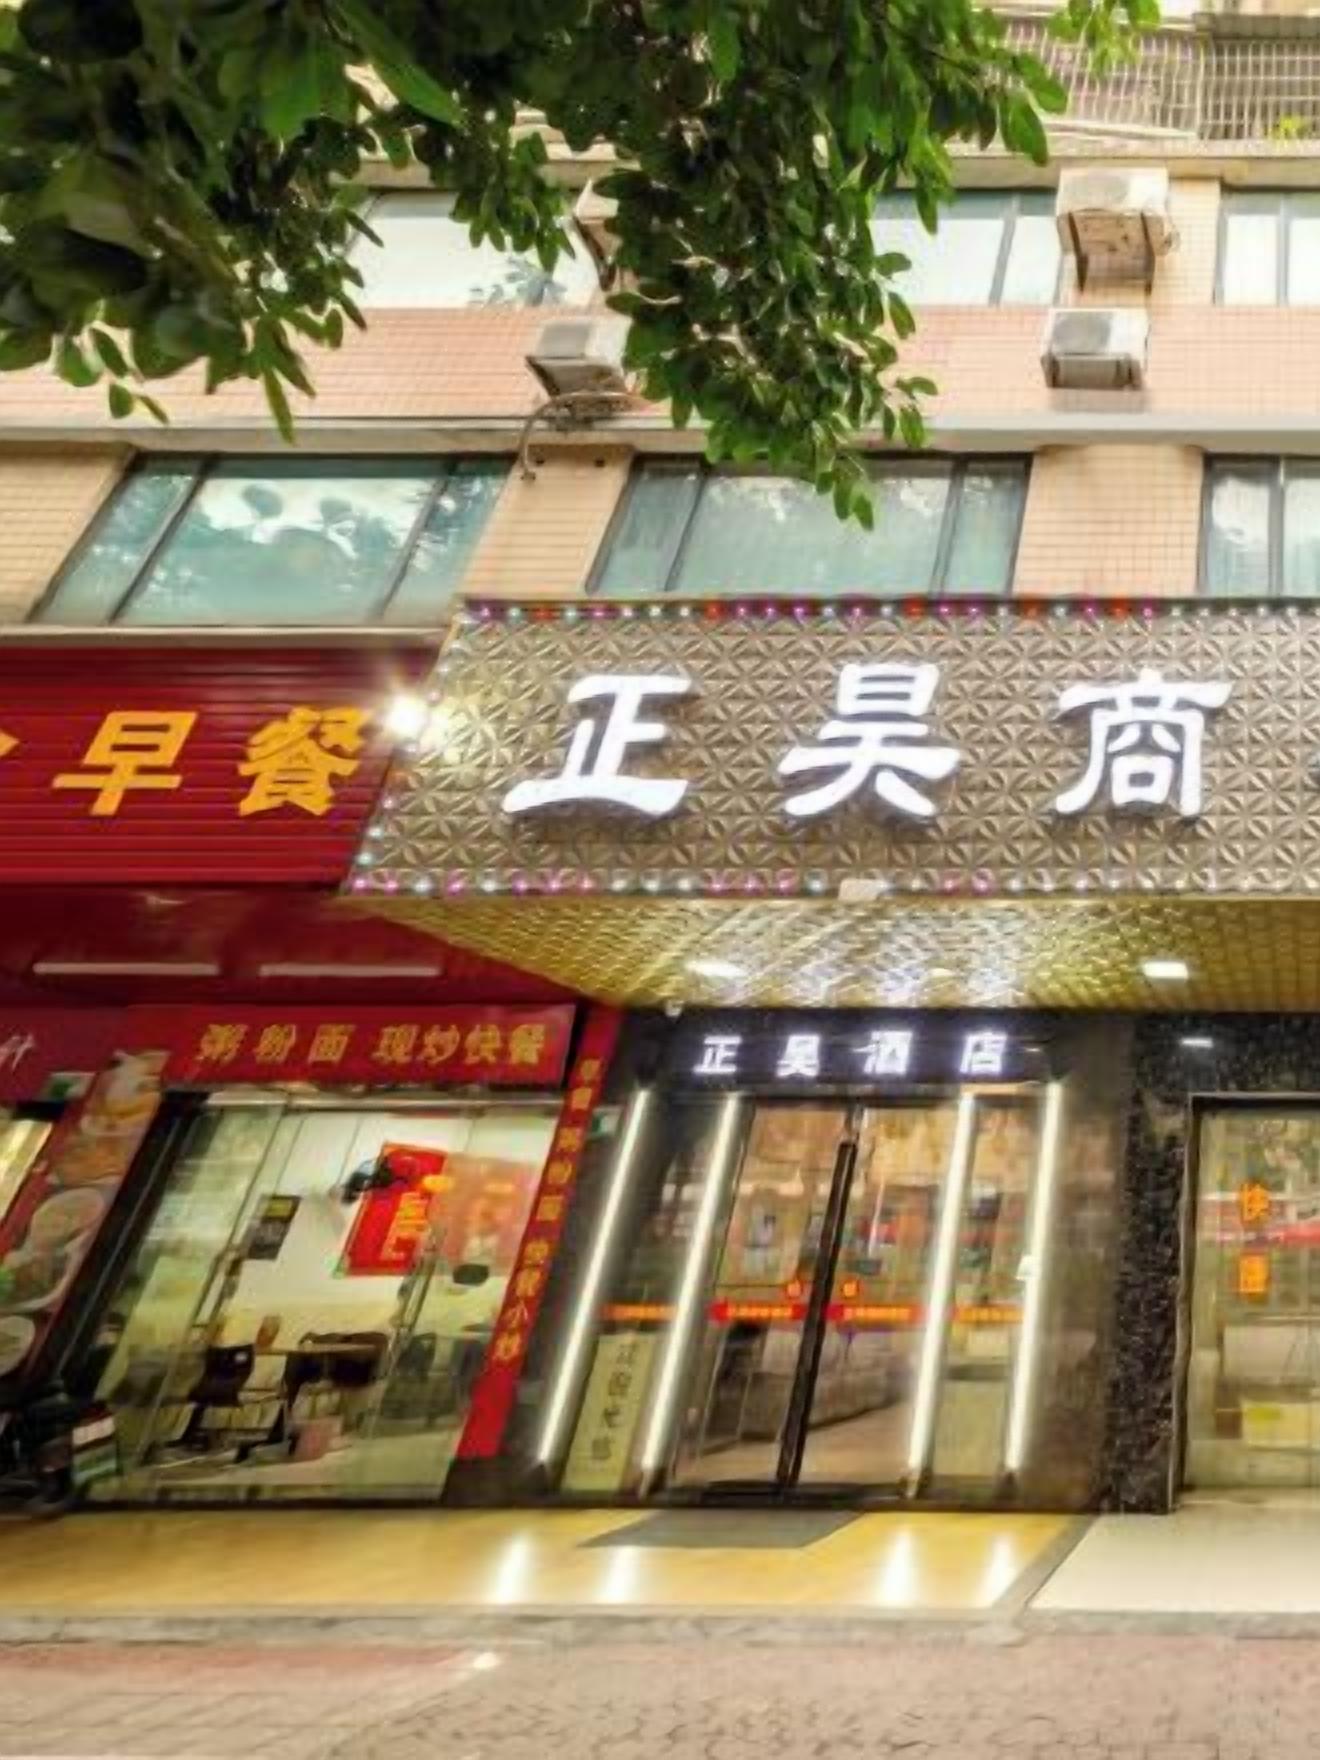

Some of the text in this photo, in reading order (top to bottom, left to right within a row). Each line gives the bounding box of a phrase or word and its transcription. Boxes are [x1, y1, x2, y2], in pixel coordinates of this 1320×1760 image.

[52, 706, 368, 816] 早餐
[692, 1030, 1007, 1078] 正昊酒店
